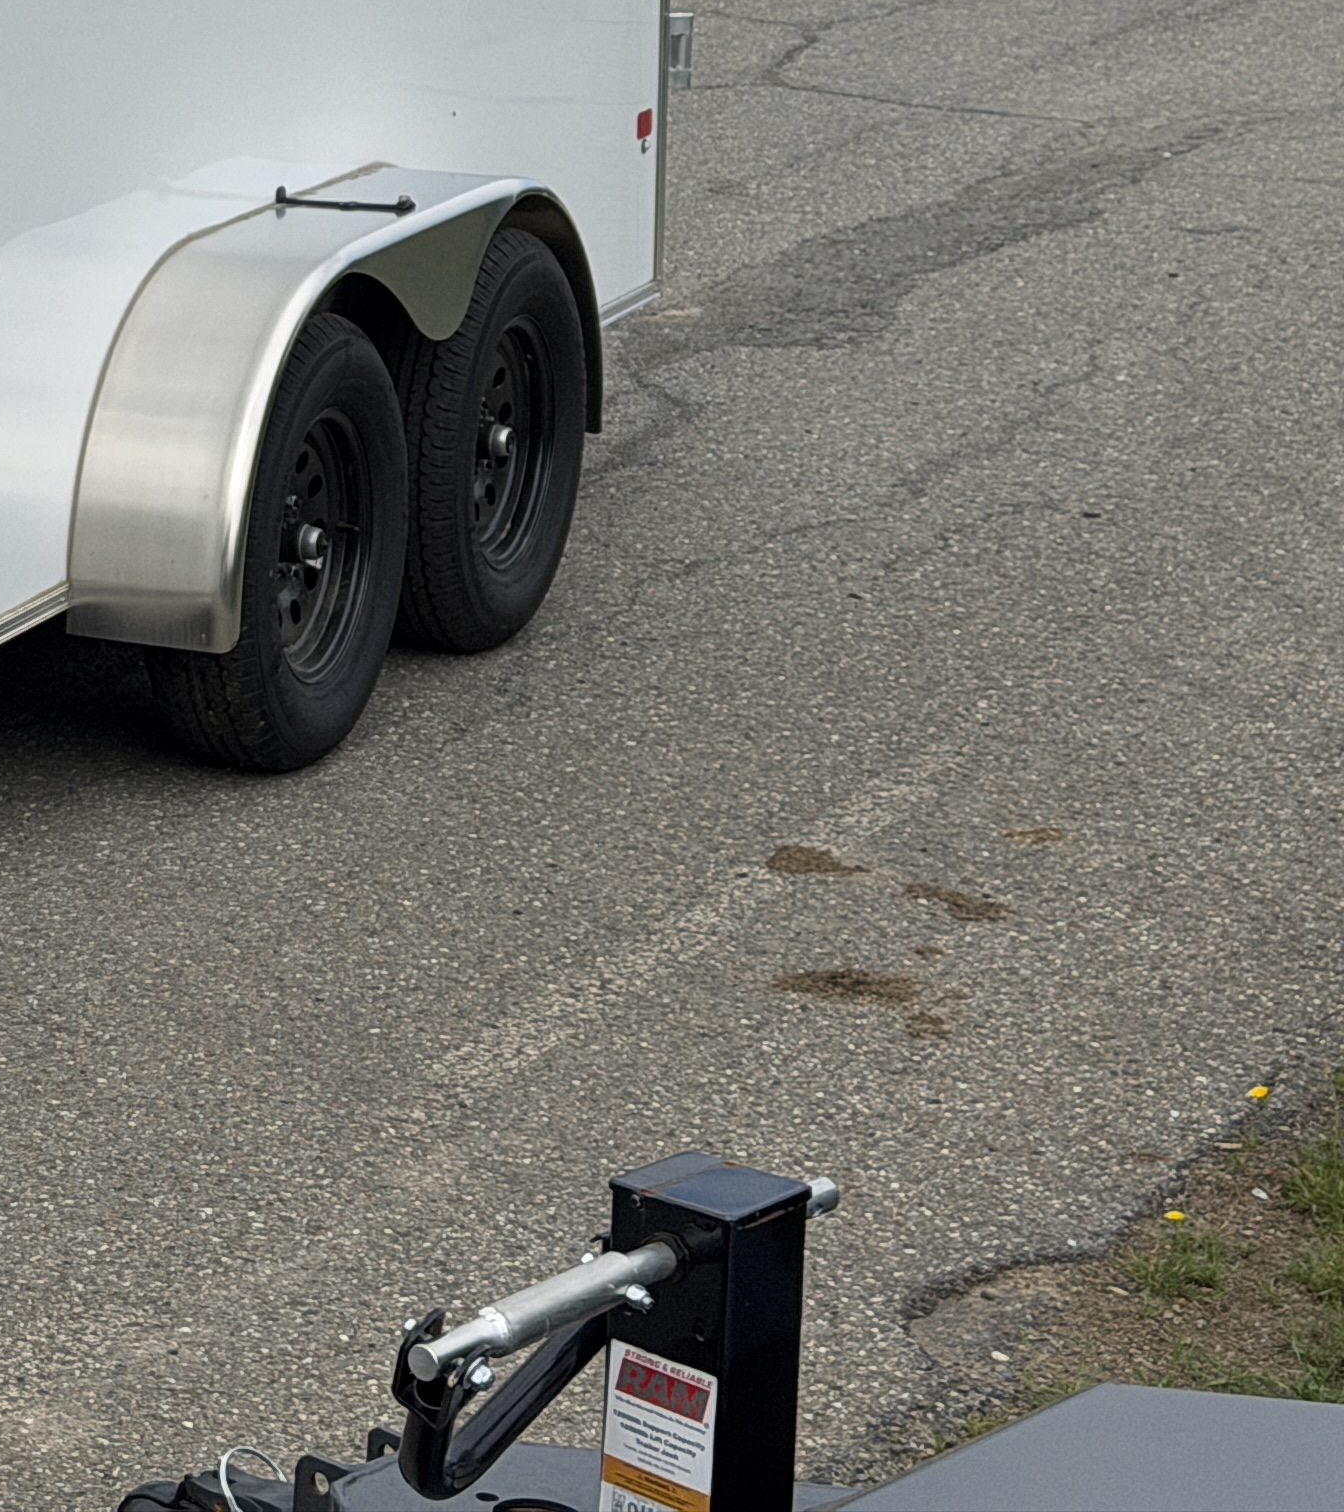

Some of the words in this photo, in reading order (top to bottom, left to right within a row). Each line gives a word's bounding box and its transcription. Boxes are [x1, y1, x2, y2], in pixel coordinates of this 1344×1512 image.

[620, 1362, 706, 1420] RAM
[624, 1349, 662, 1368] STRONG
[662, 1363, 669, 1372] &
[670, 1366, 713, 1388] RELIABLE
